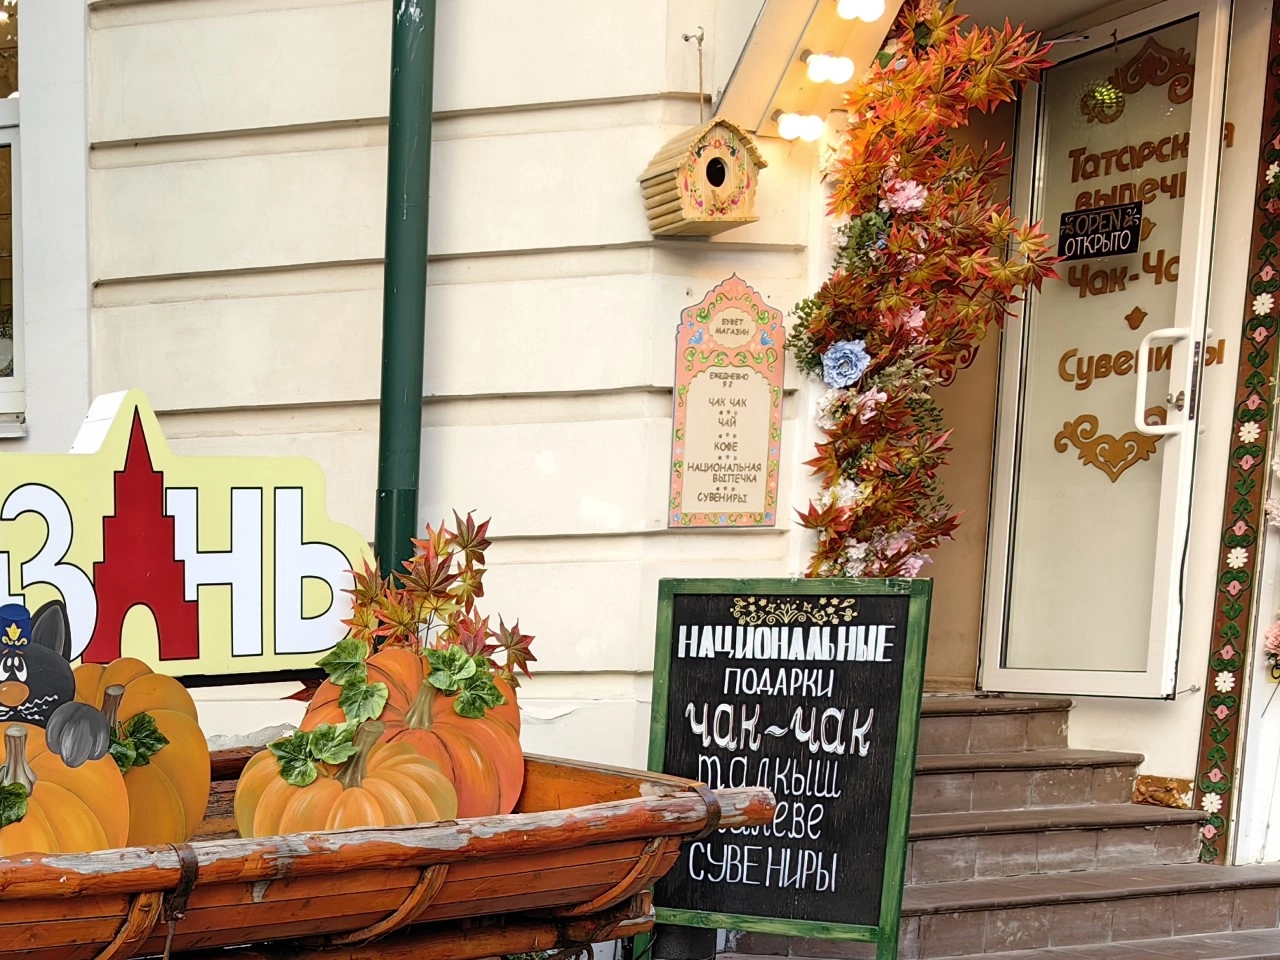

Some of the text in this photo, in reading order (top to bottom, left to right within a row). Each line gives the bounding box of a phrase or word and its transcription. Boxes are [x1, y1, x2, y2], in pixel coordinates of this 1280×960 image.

[1075, 208, 1122, 235] OPEN
[1065, 230, 1131, 256] ОТКРЫТО
[721, 318, 745, 326] БУФЕТ
[714, 327, 750, 336] МАГАЗИН
[709, 371, 749, 380] ЕЖЕДНЕВНО
[708, 397, 748, 408] ЧАК ЧАК
[718, 416, 737, 428] ЧАЙ
[713, 441, 739, 452] КОФЕ
[687, 462, 762, 473] НАЦИОНАЛЬНАЯ
[712, 473, 757, 484] ВЫПЕЧКА
[697, 492, 748, 503] СУВЕНИРЫ
[677, 624, 897, 662] НАЦИОНАЛЬНЫЕ
[723, 667, 835, 698] ПОДАРКИ
[688, 841, 838, 892] СУВЕНИРЫ
